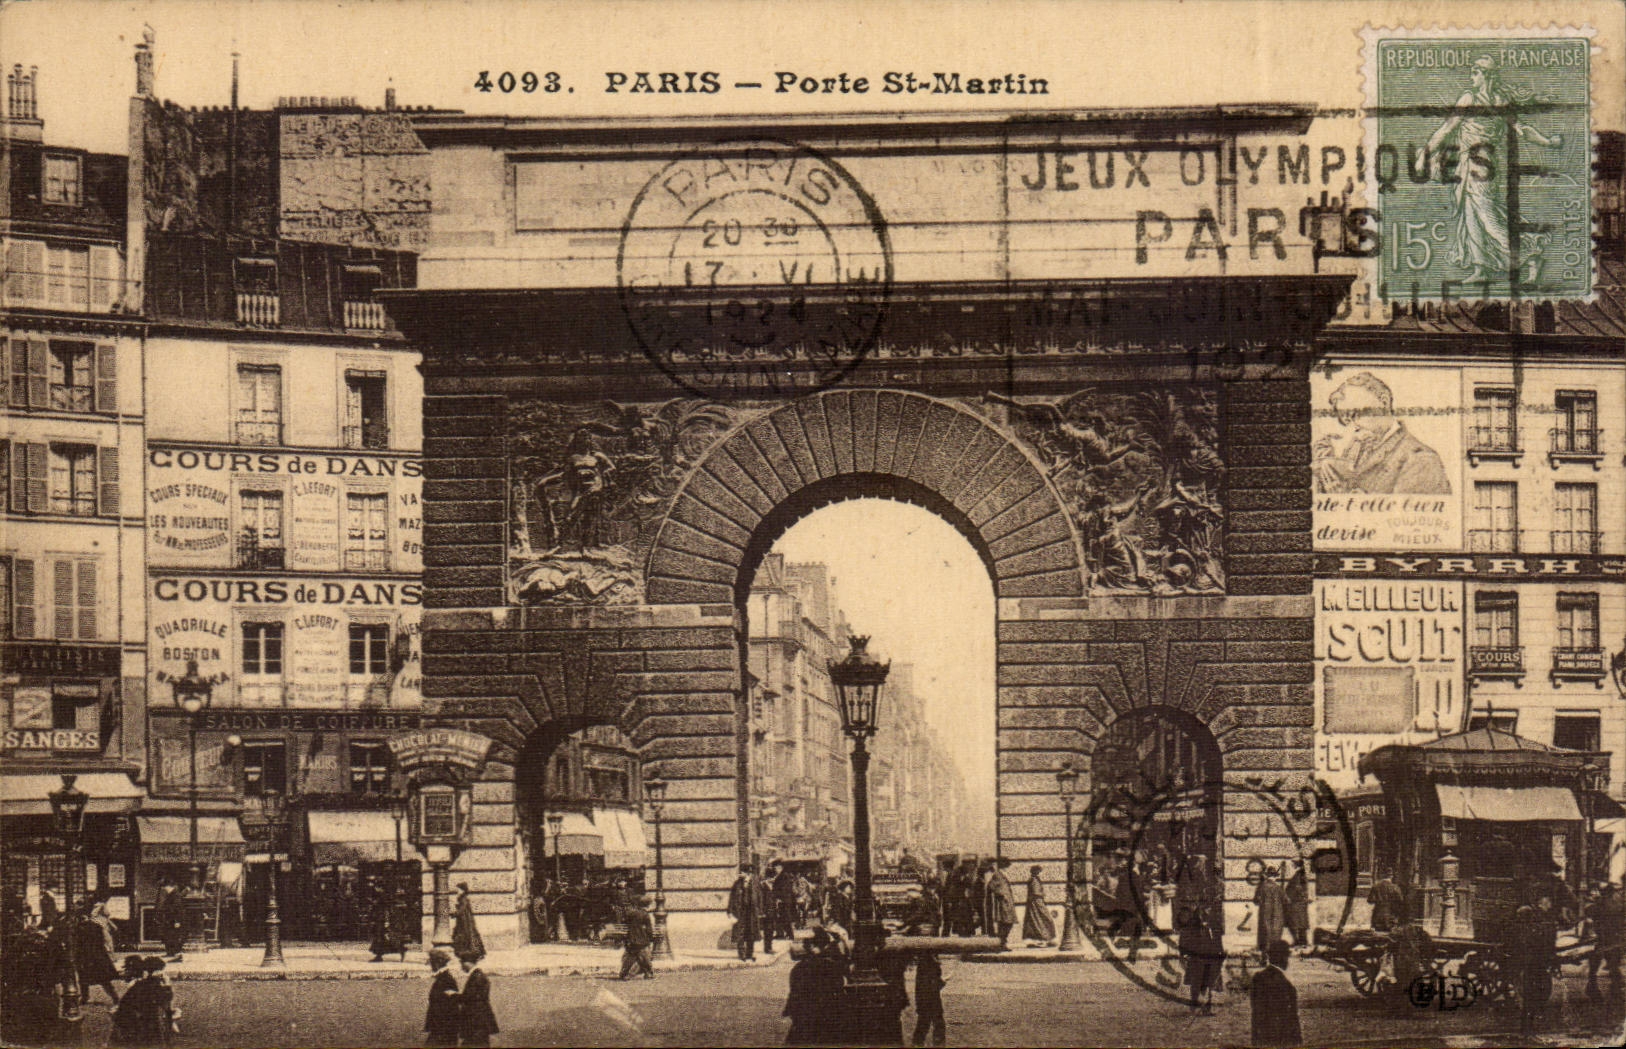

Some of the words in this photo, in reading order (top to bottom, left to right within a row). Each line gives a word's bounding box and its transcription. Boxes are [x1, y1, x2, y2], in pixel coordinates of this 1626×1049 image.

[1386, 49, 1471, 67] REPUBLIQUE
[1562, 198, 1582, 281] POSTES
[150, 450, 280, 473] COURS
[287, 456, 317, 475] de
[326, 457, 423, 477] DANS
[1316, 524, 1377, 542] devise
[1392, 532, 1443, 544] MIEUX
[1338, 557, 1581, 574] BYRRH
[154, 578, 289, 604] COURS
[294, 583, 317, 605] de
[321, 583, 423, 606] DANS
[1321, 584, 1460, 613] MEILLEUR
[154, 617, 228, 640] QUADRILLE
[162, 646, 221, 661] BOSTON
[1478, 651, 1520, 663] COURS
[206, 715, 267, 729] SALON
[280, 715, 303, 729] DE
[5, 730, 100, 749] SANGES
